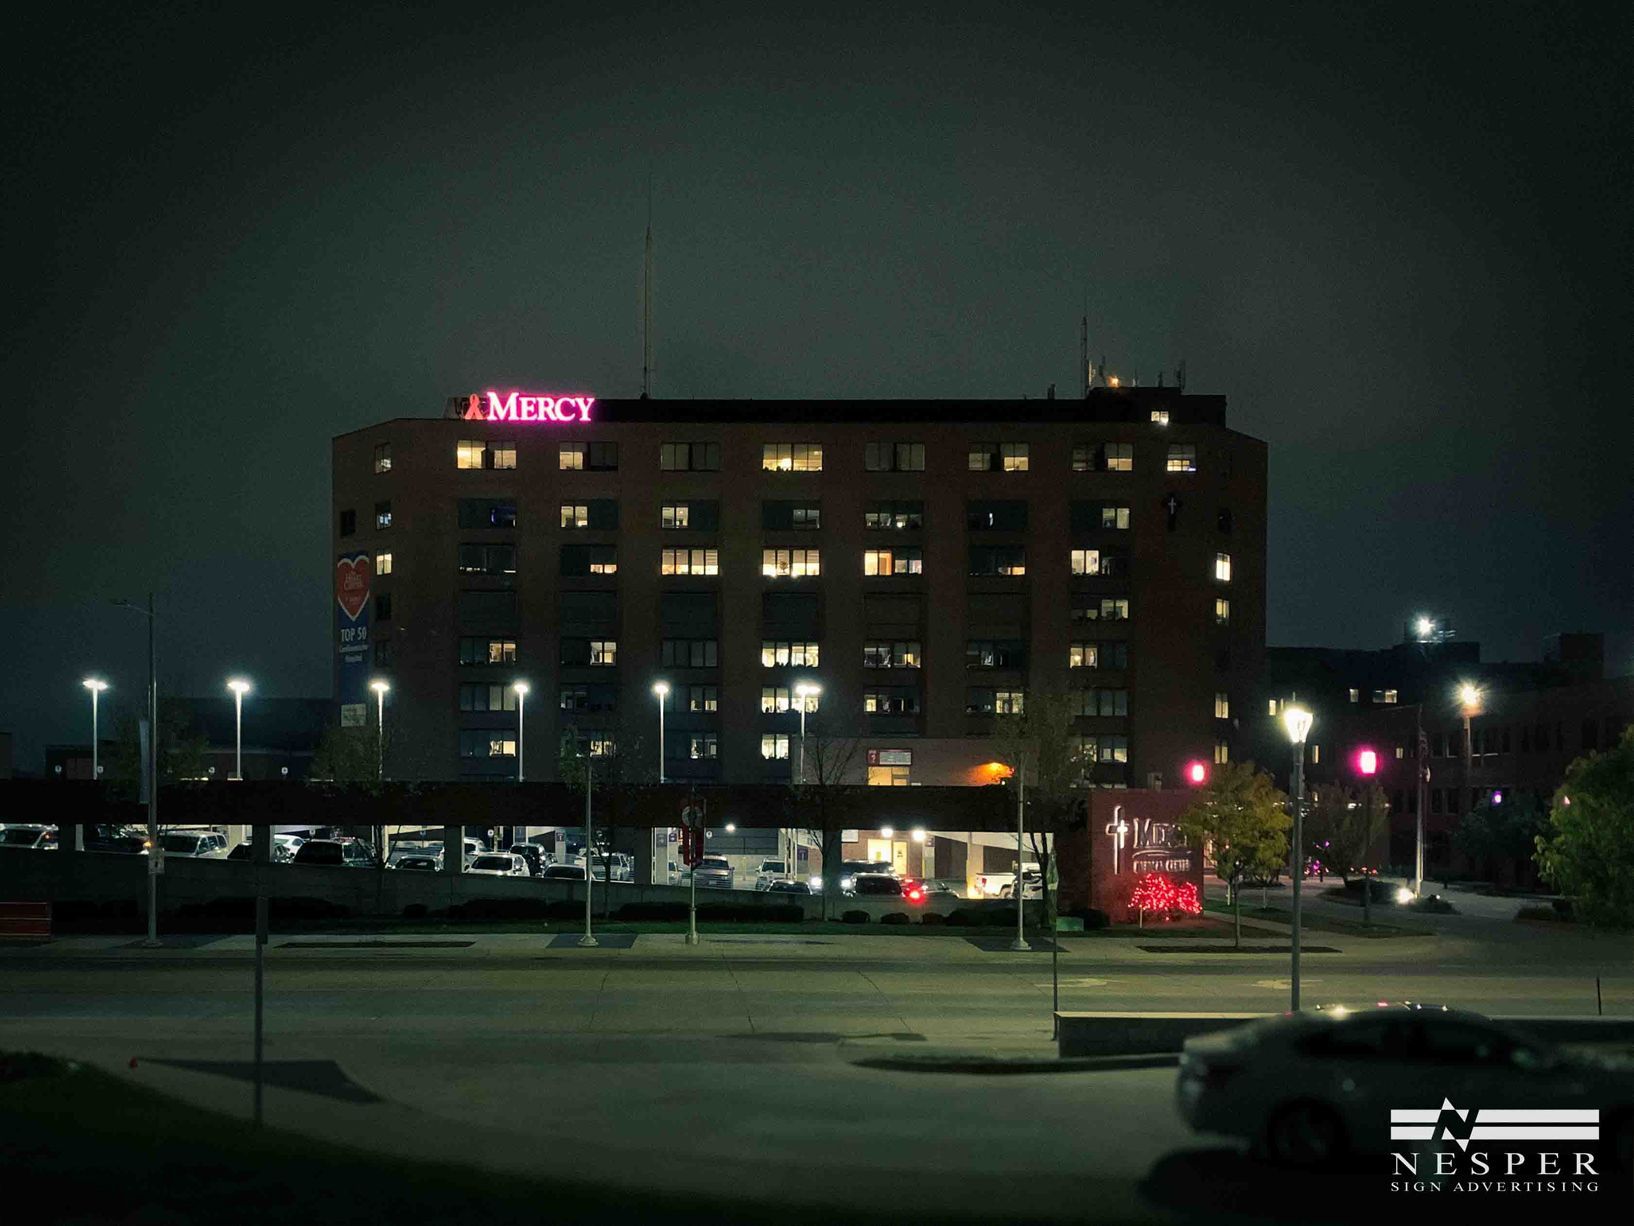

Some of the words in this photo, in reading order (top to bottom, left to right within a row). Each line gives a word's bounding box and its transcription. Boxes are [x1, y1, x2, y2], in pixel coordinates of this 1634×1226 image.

[486, 391, 596, 422] MERCY
[340, 628, 356, 642] TOP
[357, 626, 367, 641] 50
